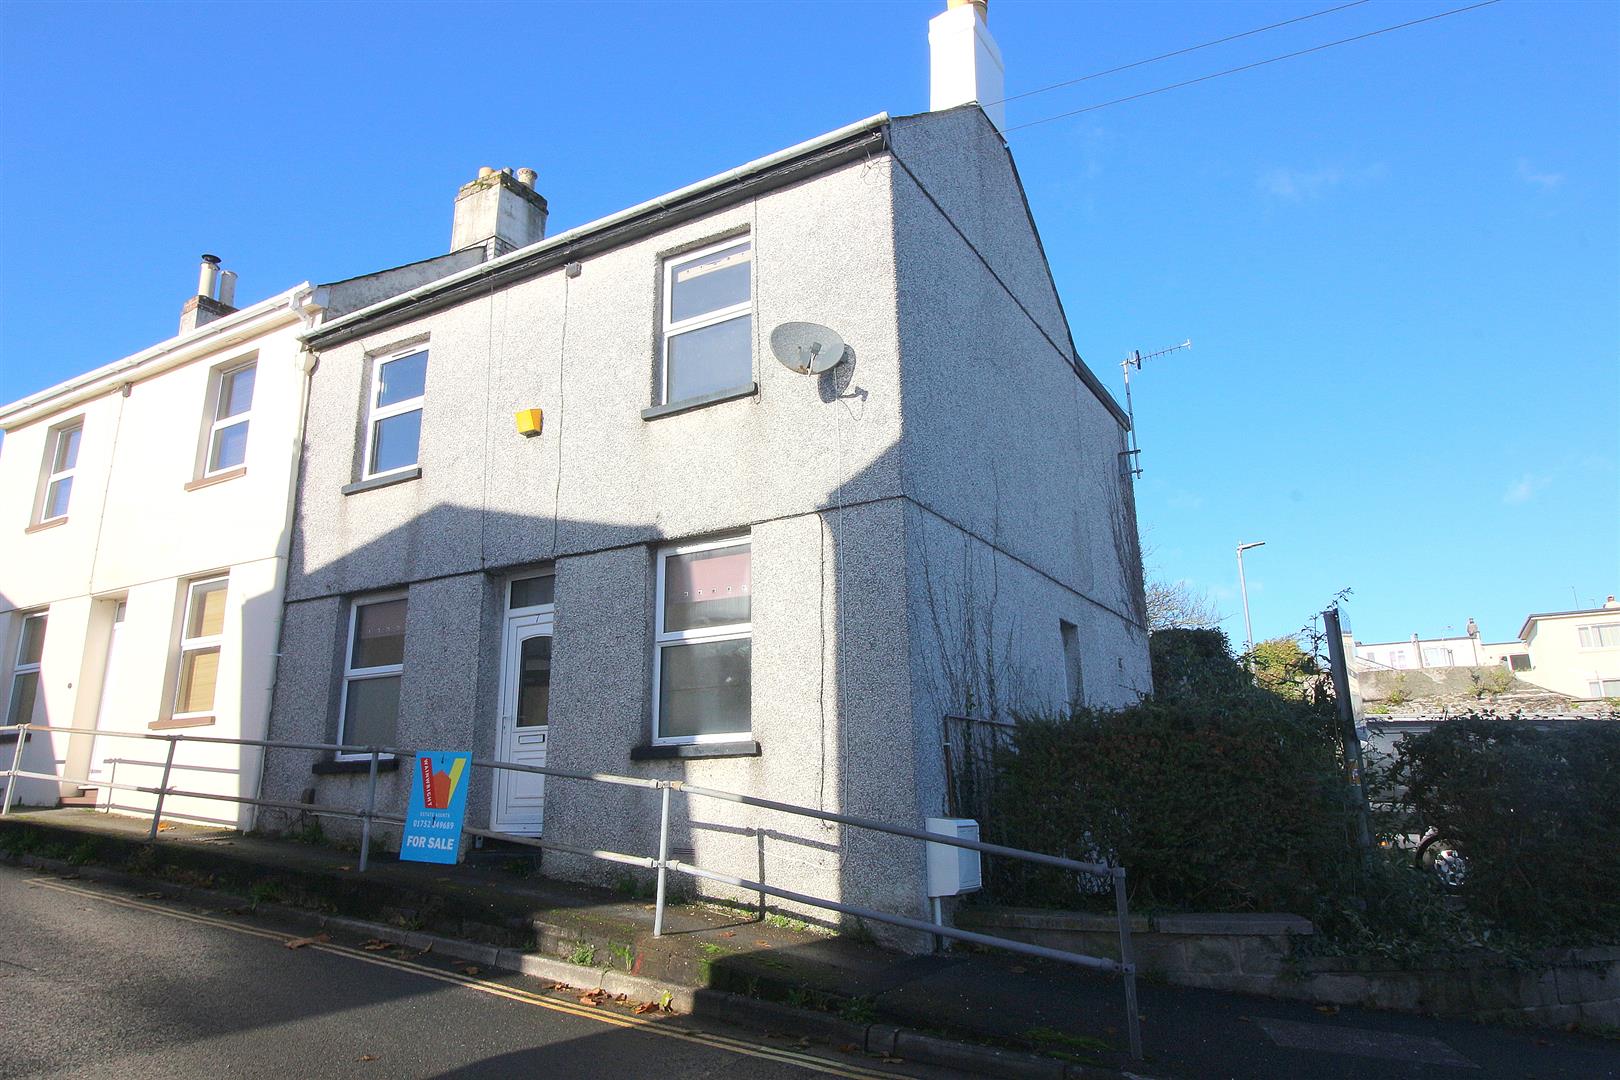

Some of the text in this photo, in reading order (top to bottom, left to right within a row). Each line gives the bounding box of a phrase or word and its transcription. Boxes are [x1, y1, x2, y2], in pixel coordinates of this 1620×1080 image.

[423, 758, 433, 806] WAINWRIGHT
[412, 820, 431, 828] 01752
[406, 835, 455, 850] FOR SALE
